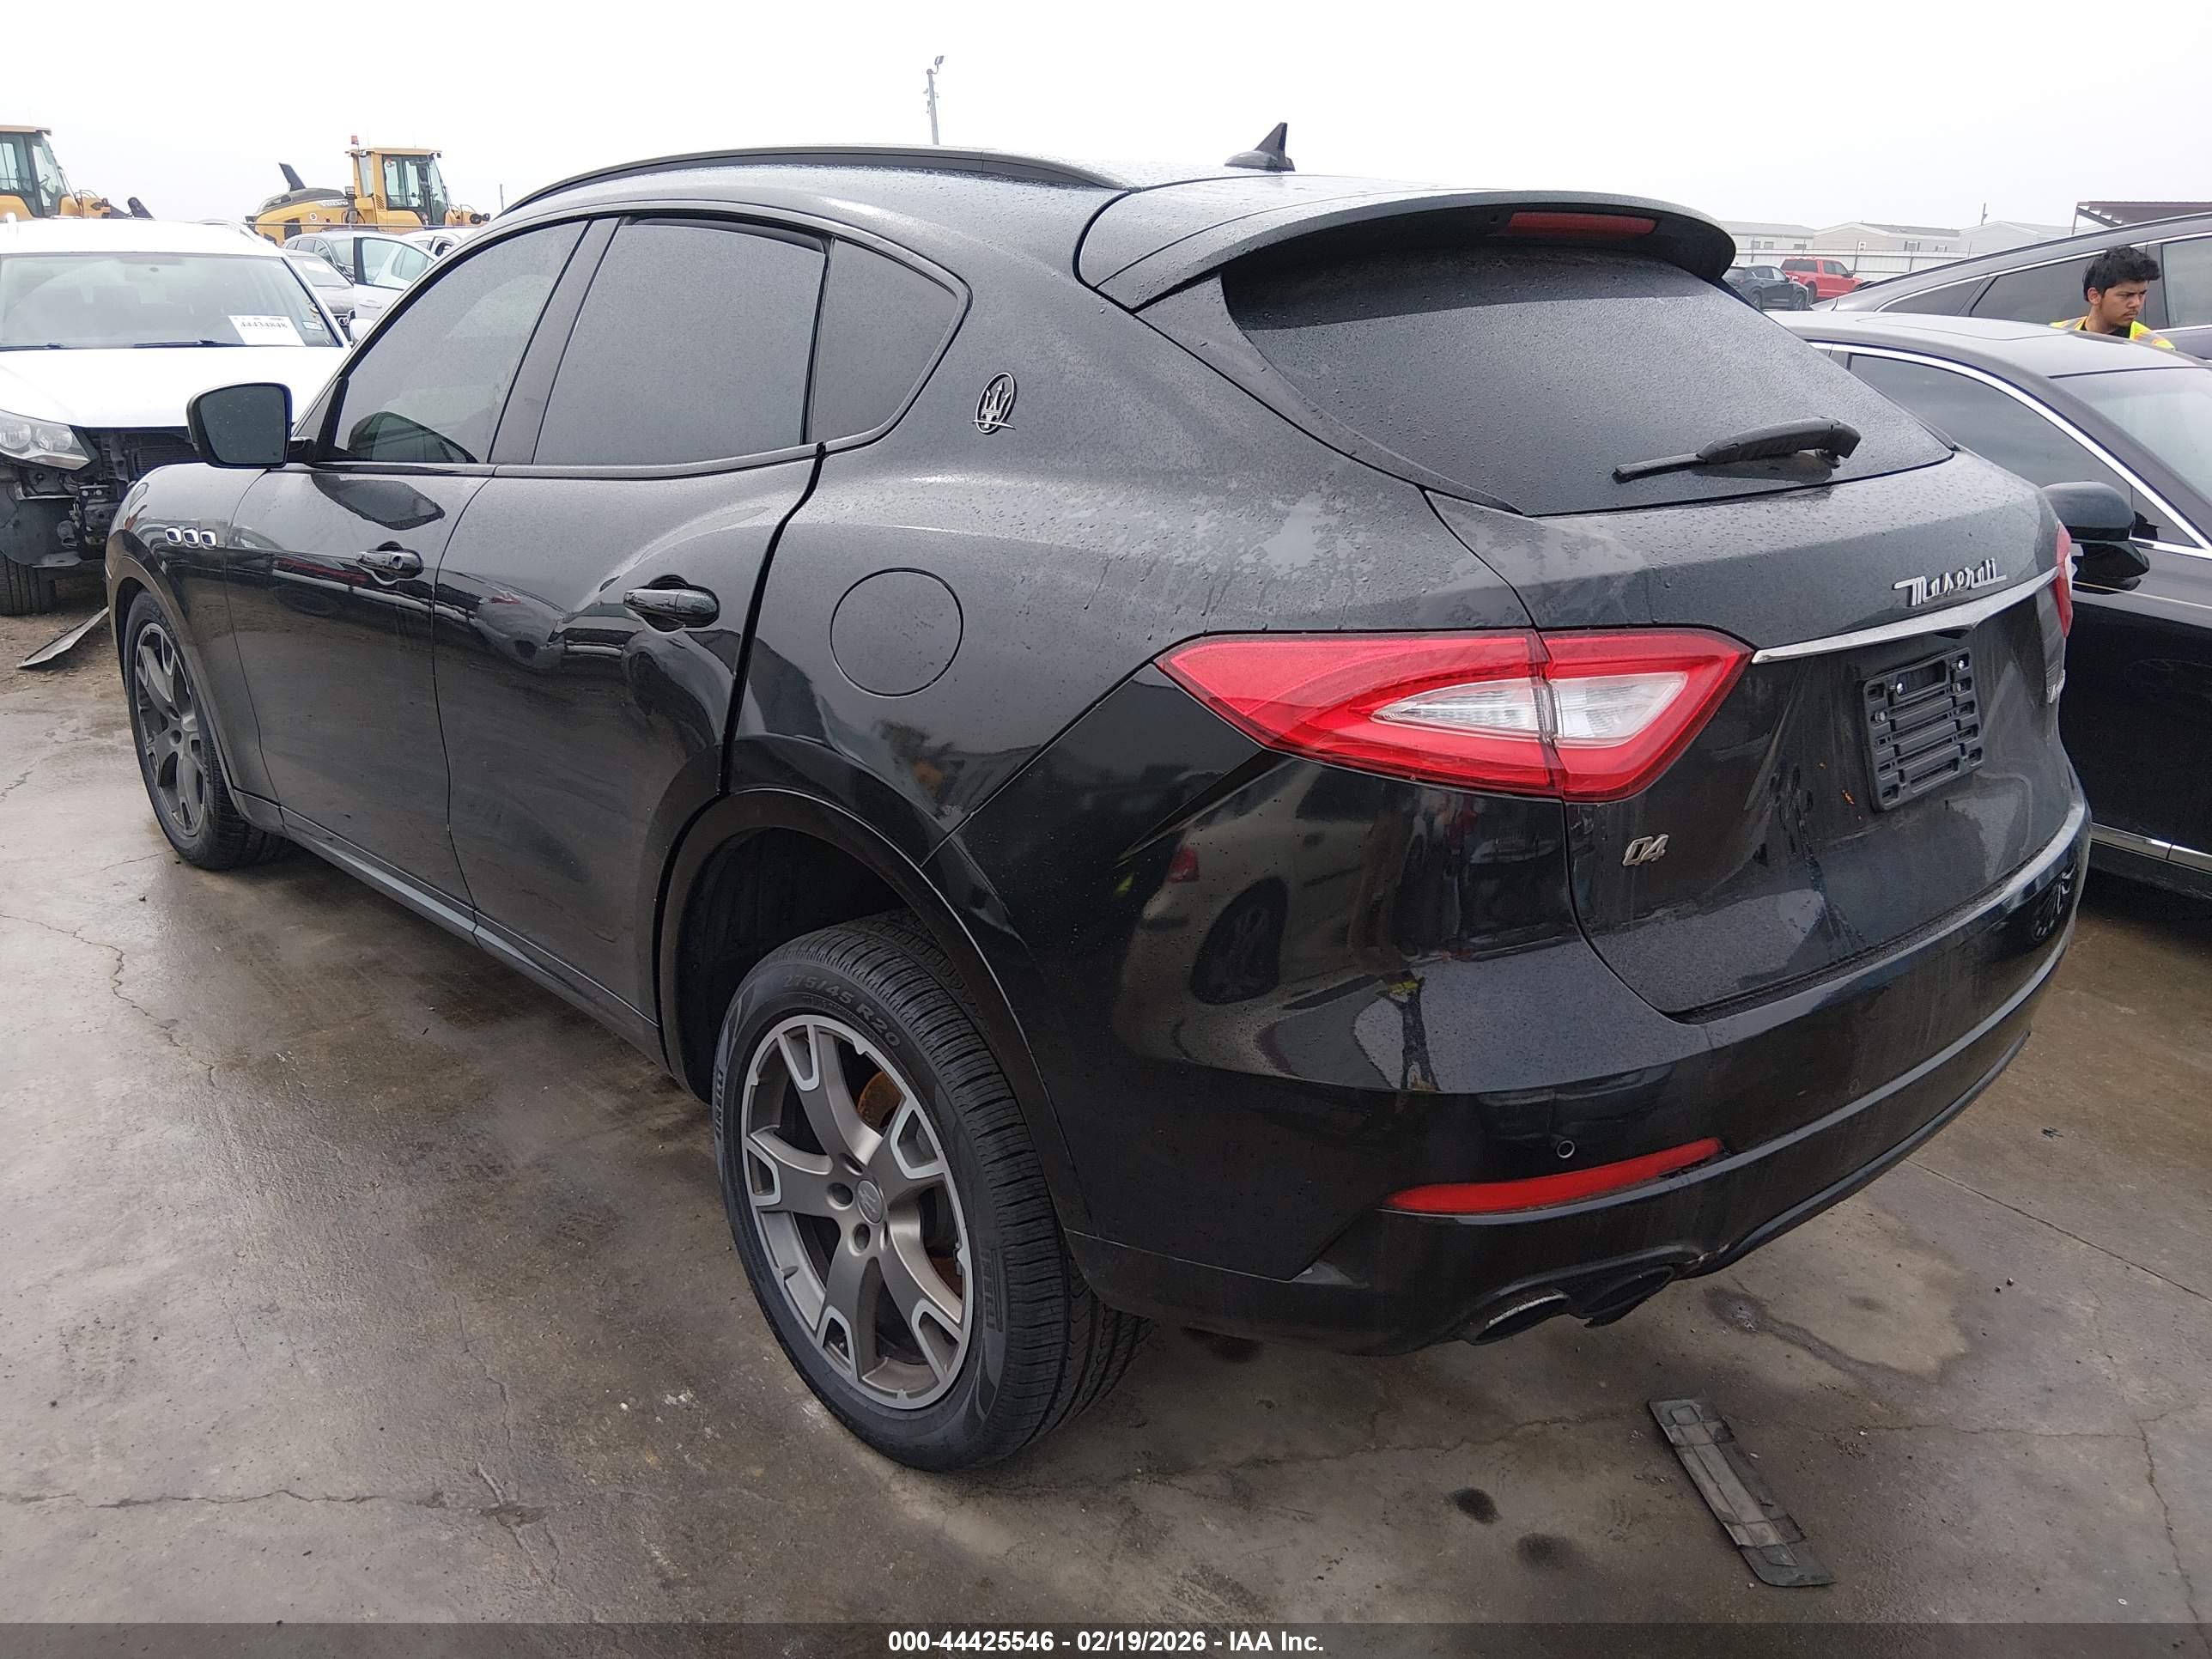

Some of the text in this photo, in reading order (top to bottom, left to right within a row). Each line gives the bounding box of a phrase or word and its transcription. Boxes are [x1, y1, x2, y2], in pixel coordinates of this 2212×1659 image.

[1893, 557, 2006, 606] Maserati
[1622, 834, 1669, 866] Q4
[782, 975, 854, 1004] 275/45
[856, 1003, 900, 1047] R20
